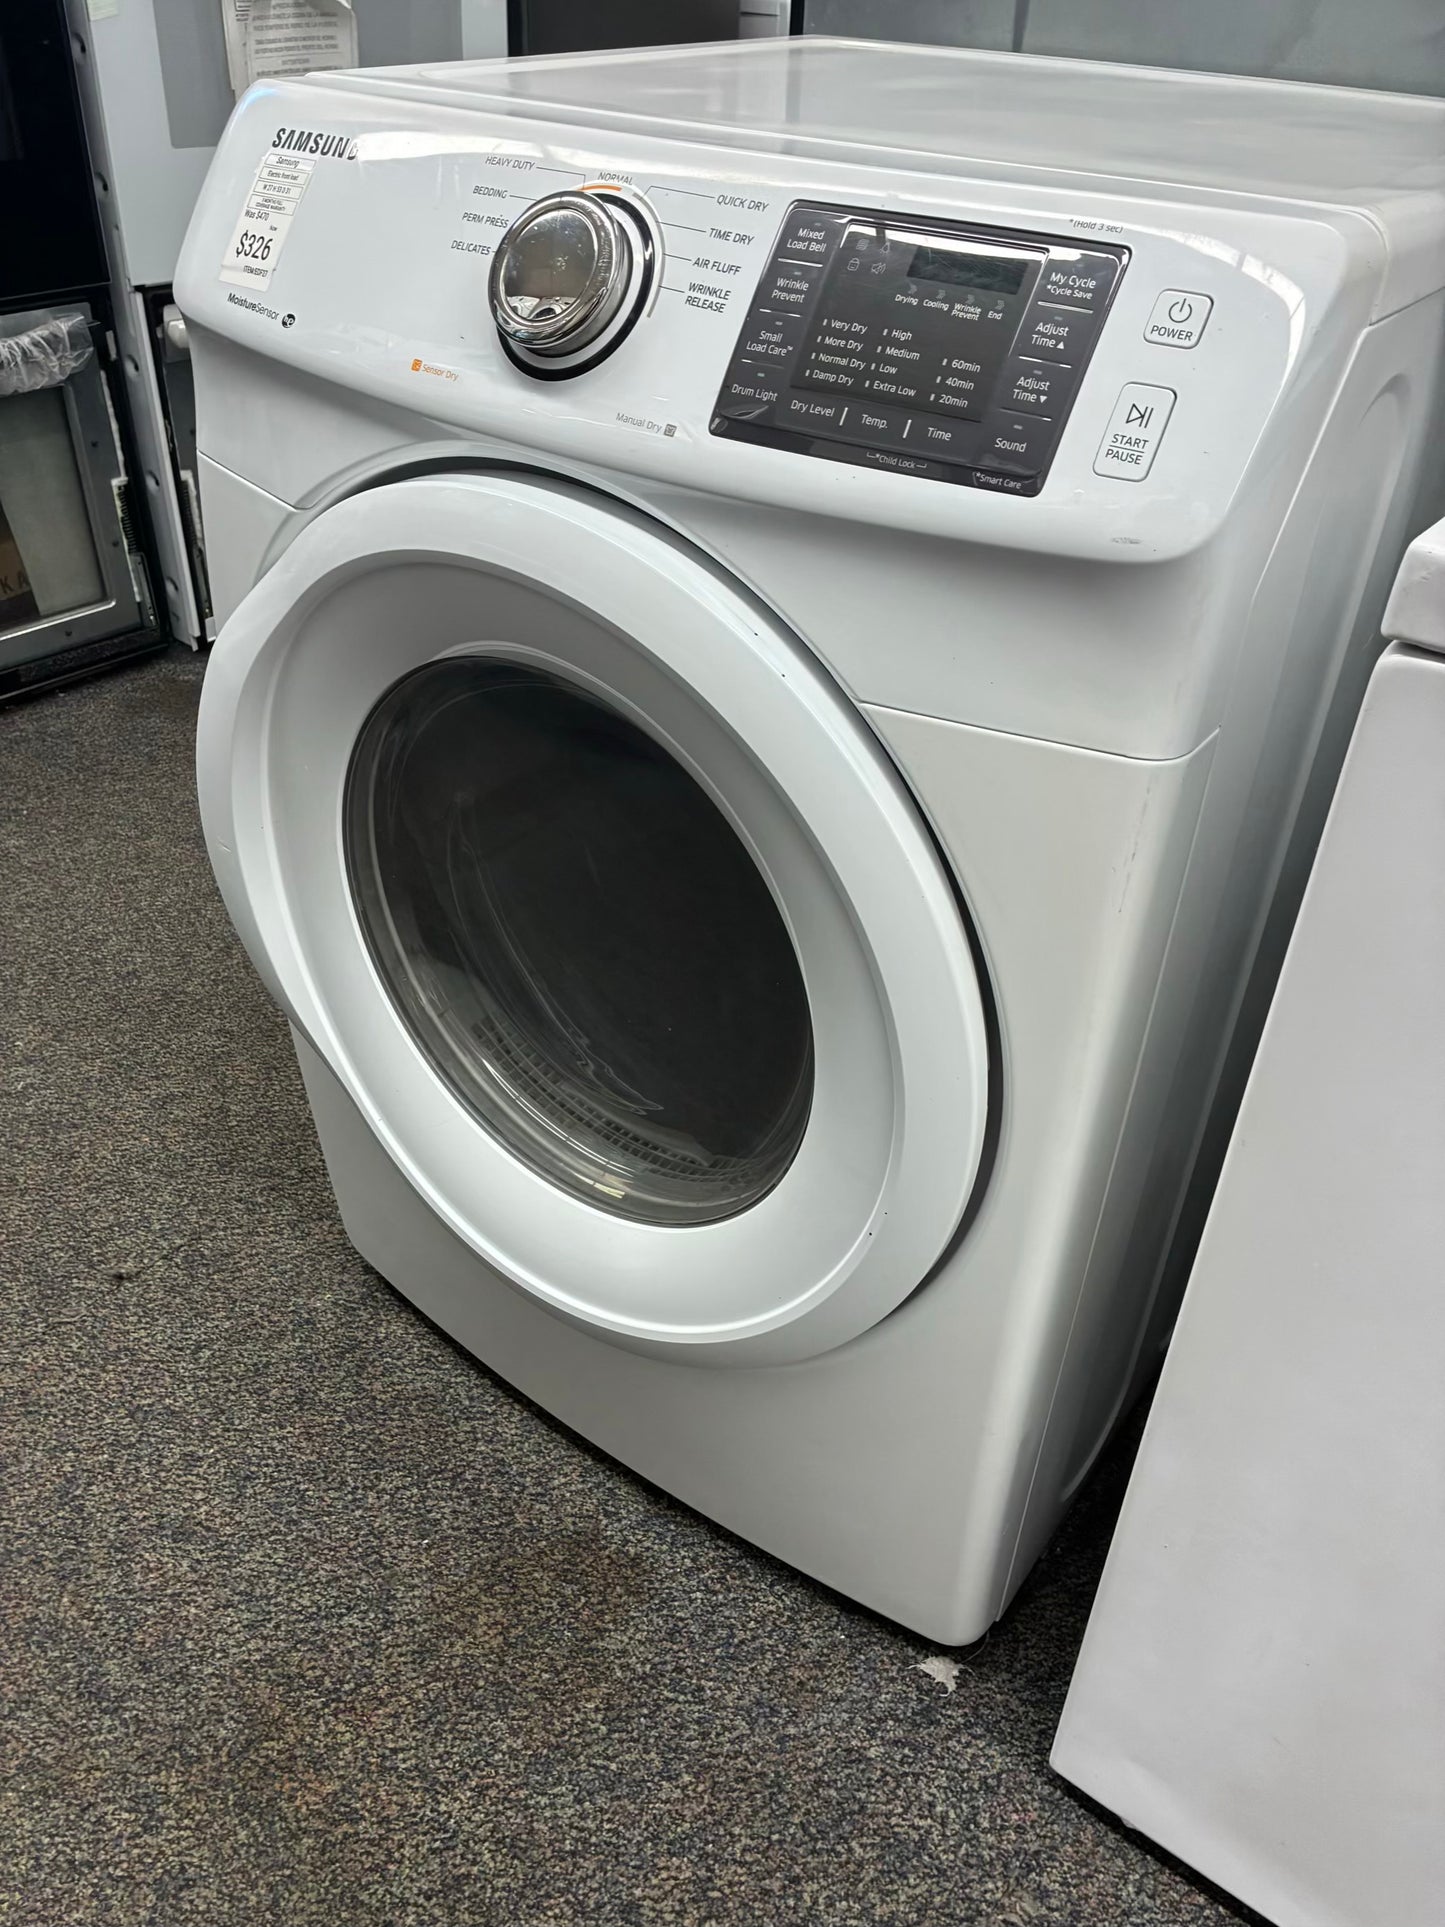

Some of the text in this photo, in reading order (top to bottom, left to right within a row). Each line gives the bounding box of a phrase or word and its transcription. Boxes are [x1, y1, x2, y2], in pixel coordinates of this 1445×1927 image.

[276, 156, 300, 169] Samsung
[485, 155, 535, 171] HEAVY DUTY
[598, 171, 634, 186] NORMAL
[472, 185, 508, 199] BEDDING
[716, 194, 769, 212] QUICK DRY
[244, 209, 256, 219] Was
[462, 212, 509, 228] PERM PRESS
[797, 227, 825, 240] Mixed
[1098, 223, 1104, 231] 3
[1105, 224, 1124, 234] sec)
[709, 227, 755, 246] TIME DRY
[236, 229, 273, 261] $326
[451, 240, 491, 256] DELICATES
[786, 238, 827, 253] Load Bell
[692, 257, 742, 275] AIR FLUFF
[776, 277, 809, 291] Wrinkle
[1050, 272, 1097, 289] My Cycle
[688, 281, 731, 300] WRINKLE
[771, 289, 805, 303] Prevent
[1073, 288, 1093, 300] Save
[227, 292, 280, 320] MoistureSensor
[684, 295, 726, 313] RELEASE
[895, 294, 919, 306] Drying
[923, 299, 950, 311] Cooling
[951, 309, 980, 321] Prevent
[954, 303, 982, 315] Wrinkle
[987, 310, 1003, 320] End
[831, 318, 868, 334] Very Dry
[1035, 321, 1070, 337] Adjust
[1150, 324, 1193, 342] POWER
[758, 330, 783, 343] Small
[891, 328, 913, 341] High
[1031, 334, 1056, 348] Time
[746, 341, 767, 353] Load
[823, 336, 864, 352] More Dry
[885, 346, 920, 360] Medium
[818, 353, 867, 371] Normal Dry
[879, 363, 898, 375] Low
[951, 359, 981, 373] 60min
[422, 364, 459, 382] Sensor Dry
[812, 369, 854, 386] Damp Dry
[873, 380, 917, 397] Extra Low
[945, 377, 975, 391] 40min
[1016, 375, 1050, 391] Adjust
[731, 383, 778, 402] Drum Light
[1012, 388, 1038, 403] Time
[790, 399, 835, 417] Dry Level
[938, 394, 968, 408] 20min
[616, 412, 662, 433] Manual Dry
[861, 414, 888, 429] Temp.
[926, 426, 952, 441] Time
[1111, 433, 1149, 449] START
[994, 437, 1027, 453] Sound
[898, 457, 916, 469] Lock
[1105, 448, 1143, 465] PAUSE
[1003, 477, 1022, 490] Care
